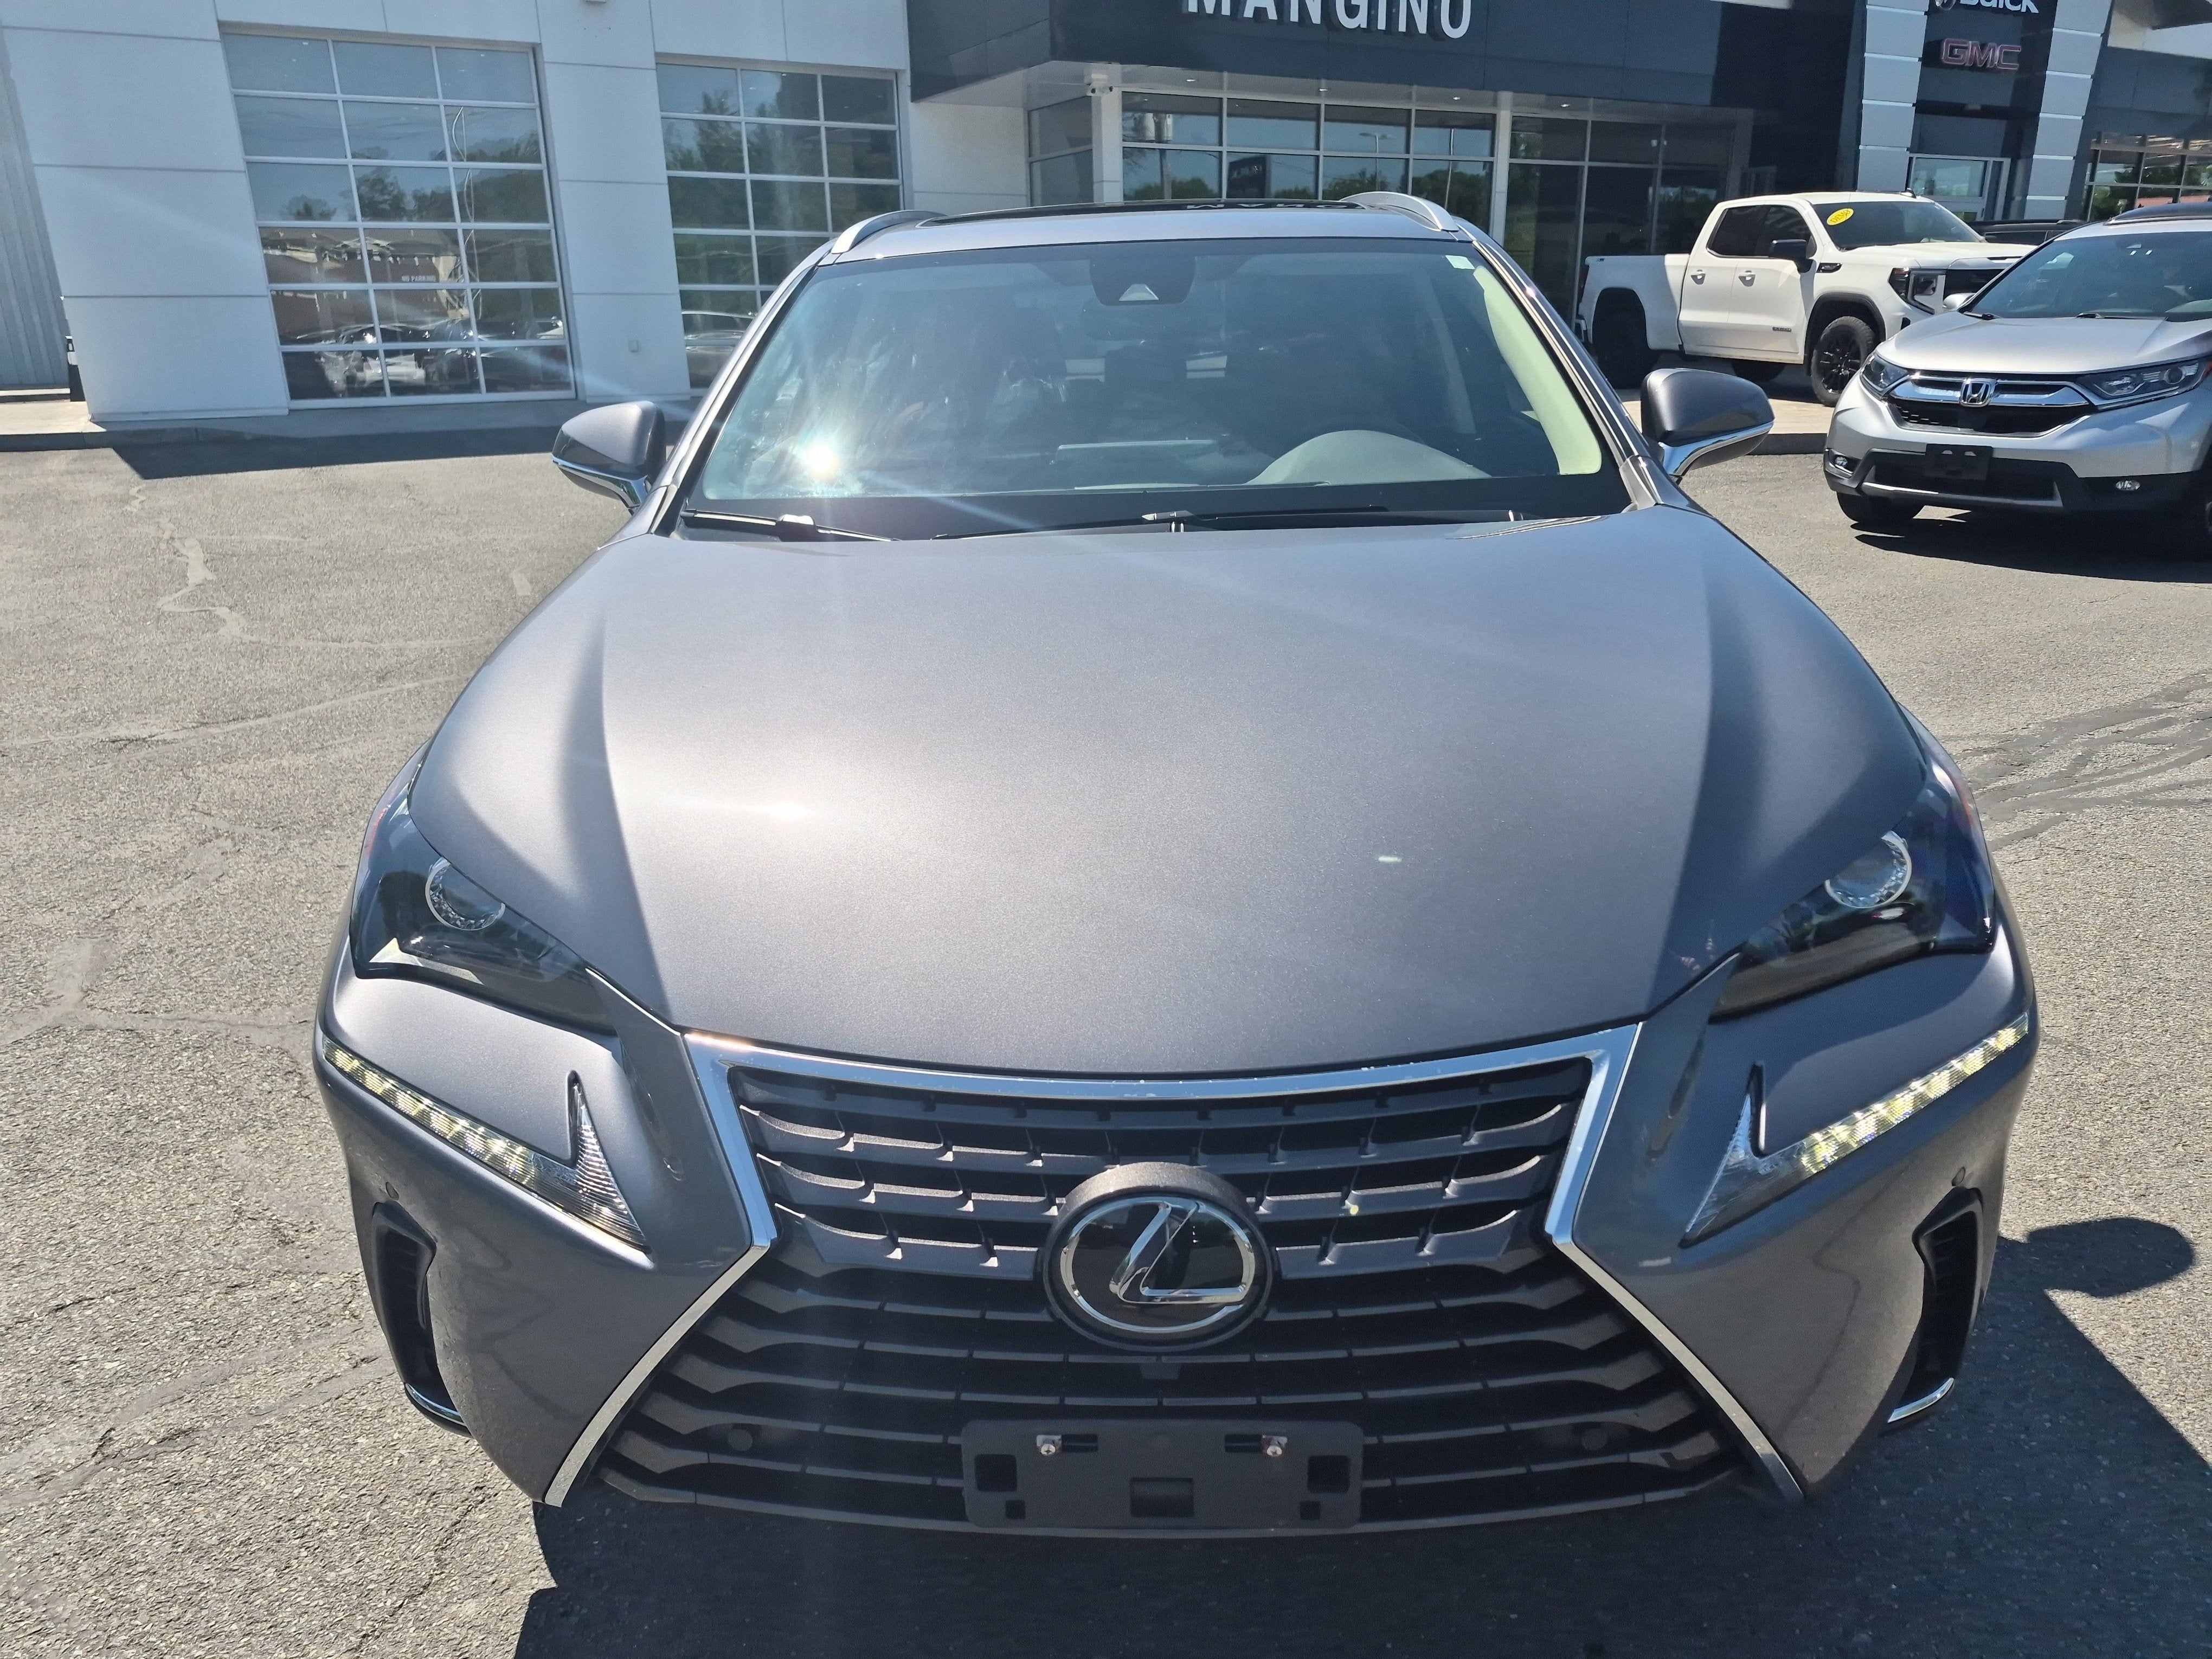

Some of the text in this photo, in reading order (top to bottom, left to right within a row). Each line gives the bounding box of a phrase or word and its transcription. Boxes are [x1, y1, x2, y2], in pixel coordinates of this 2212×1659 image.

[1188, 0, 1471, 38] GINO
[1960, 0, 2039, 14] uck
[1943, 38, 2021, 69] GMC
